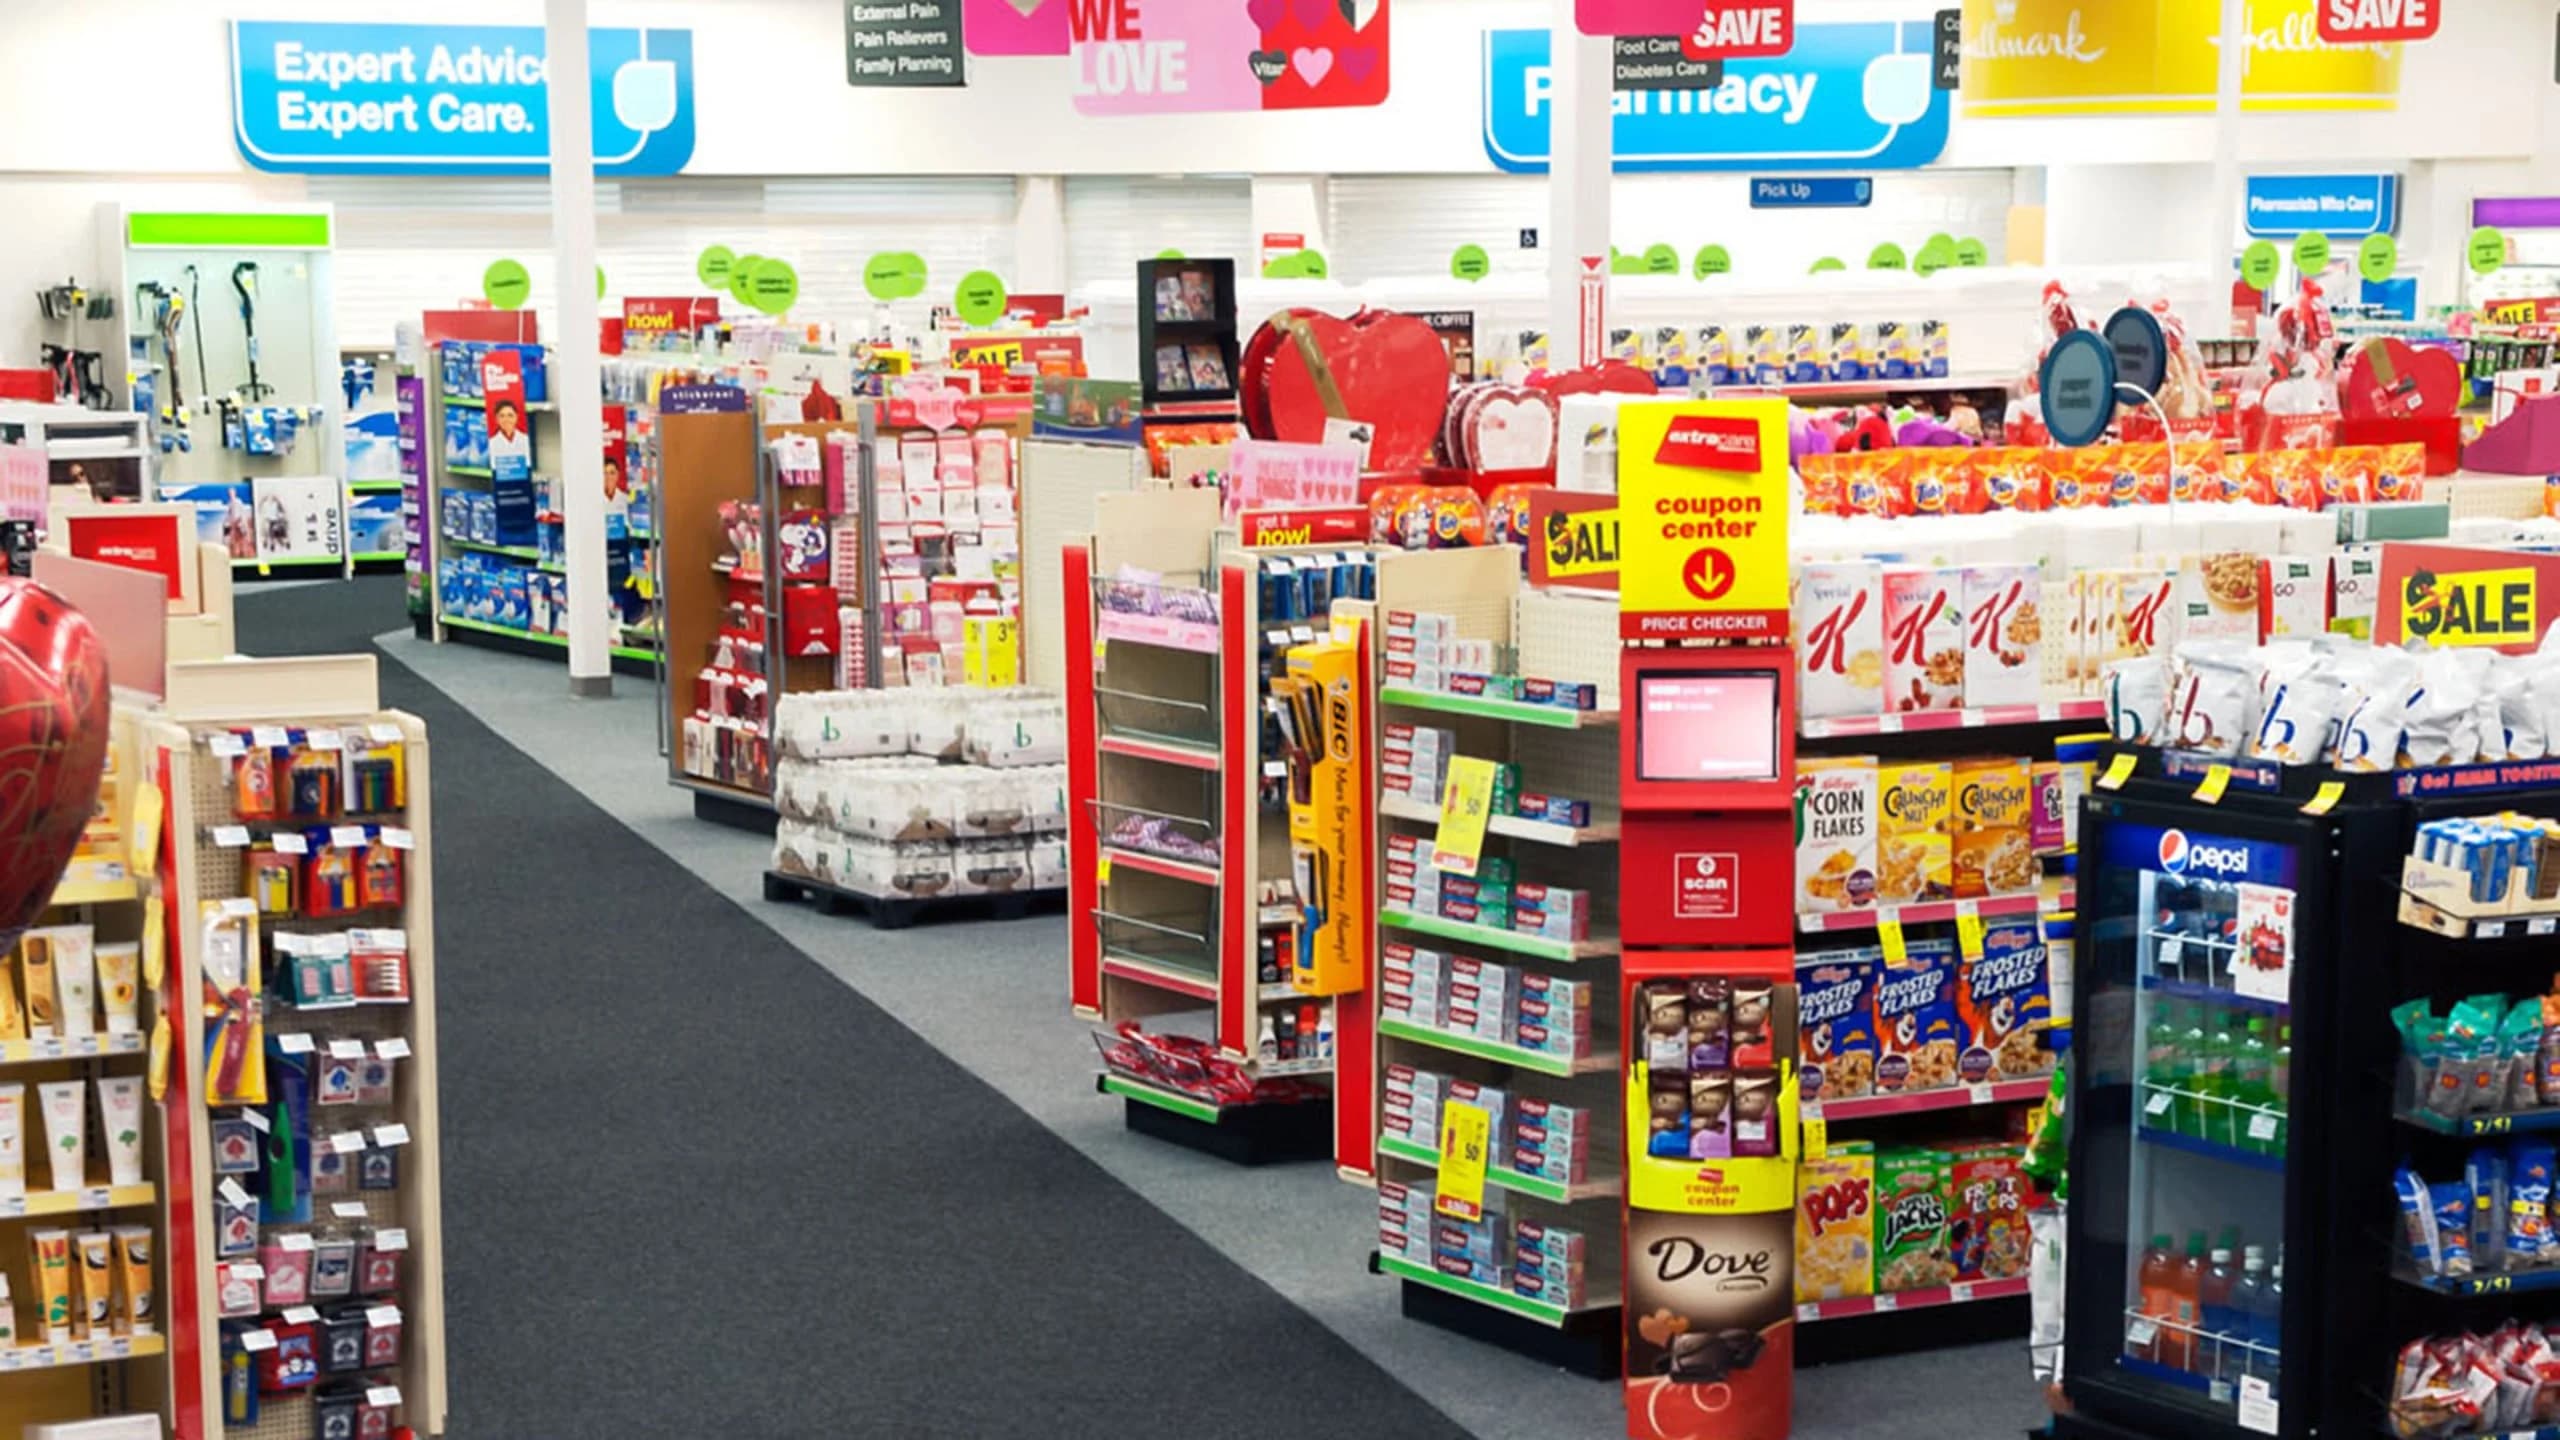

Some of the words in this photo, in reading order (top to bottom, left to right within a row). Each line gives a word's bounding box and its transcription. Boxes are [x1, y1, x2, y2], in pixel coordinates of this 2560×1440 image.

[853, 5, 907, 21] External
[910, 4, 940, 19] Pain
[1069, 0, 1141, 42] WE
[1693, 8, 1782, 47] SAVE
[2329, 0, 2427, 30] SAVE
[854, 32, 884, 47] Pain
[886, 31, 948, 46] Relievers
[1616, 41, 1646, 55] Foot
[1648, 39, 1679, 53] Care
[274, 42, 417, 90] Expert
[855, 58, 896, 76] Family
[899, 56, 953, 74] Planning
[1073, 41, 1188, 95] LOVE
[1617, 63, 1673, 78] Diabetes
[1676, 61, 1708, 75] Care
[277, 91, 419, 140] Expert
[428, 93, 535, 133] Care.
[1758, 182, 1788, 198] Pick
[1791, 183, 1811, 199] Up
[627, 311, 674, 329] now!
[1655, 496, 1762, 518] coupon
[324, 507, 340, 554] drive
[1256, 524, 1311, 545] now!
[1548, 510, 1618, 565] SAL
[1661, 518, 1757, 539] center
[1970, 580, 2023, 654] K
[2406, 571, 2531, 636] SALE
[1642, 617, 1688, 630] PRICE
[1692, 616, 1768, 630] CHECKER
[1807, 589, 1867, 675] K
[1891, 589, 1947, 667] K
[1332, 700, 1348, 754] BIC
[1813, 791, 1864, 816] CORN
[1884, 786, 1948, 818] CRUNCHY
[1904, 806, 1929, 822] NUT
[1961, 784, 2027, 814] CRUNCHY
[1981, 804, 2008, 821] NUT
[1813, 816, 1865, 839] FLAKES
[2189, 844, 2249, 875] pepsi
[1684, 878, 1728, 890] scan
[1971, 947, 2046, 984] FROSTED
[1879, 970, 1944, 1001] FROSTED
[1972, 966, 2037, 999] FLAKES
[1881, 987, 1936, 1016] FLAKES
[1685, 1184, 1740, 1195] coupon
[1688, 1196, 1736, 1206] center
[1966, 1176, 2017, 1203] FROOT
[1973, 1194, 2018, 1213] LOOPS
[1804, 1178, 1870, 1237] POPS
[1885, 1204, 1944, 1246] JACKS
[1648, 1236, 1771, 1282] Dove
